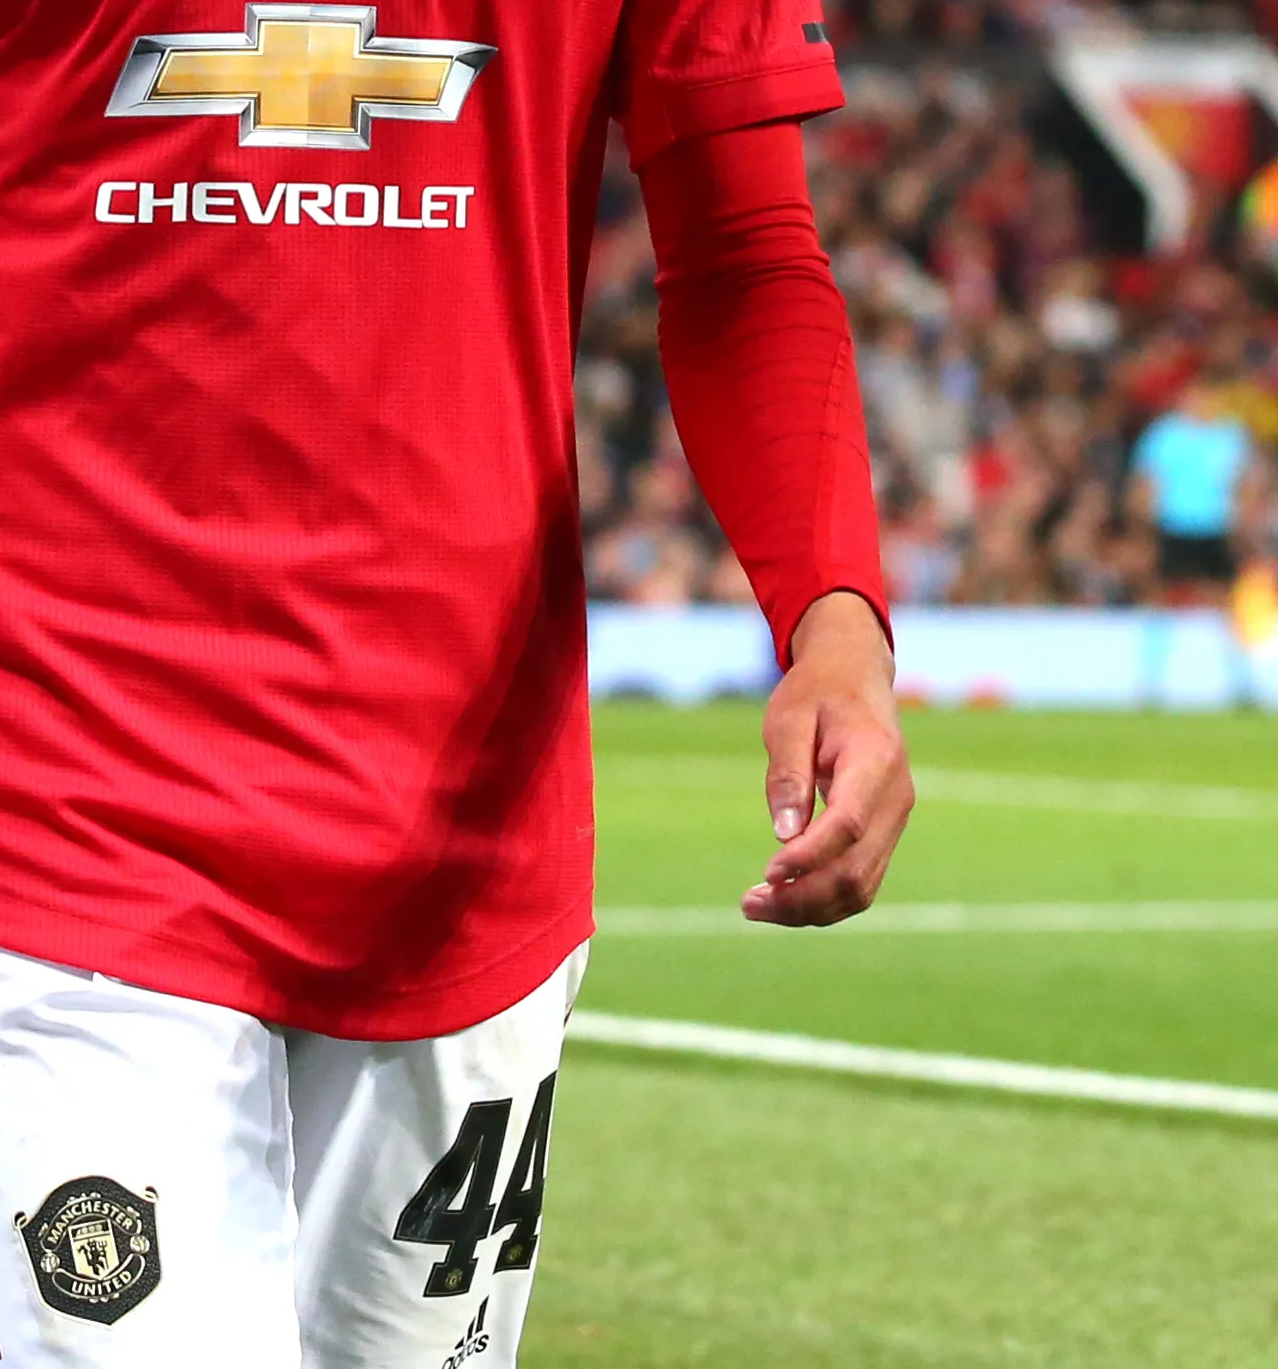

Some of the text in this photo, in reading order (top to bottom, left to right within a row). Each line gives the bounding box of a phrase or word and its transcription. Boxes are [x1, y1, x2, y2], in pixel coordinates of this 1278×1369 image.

[95, 181, 475, 229] CHEVROLET
[393, 1070, 558, 1297] 44
[47, 1200, 134, 1244] MANCHESTER
[71, 1270, 132, 1296] UNITED
